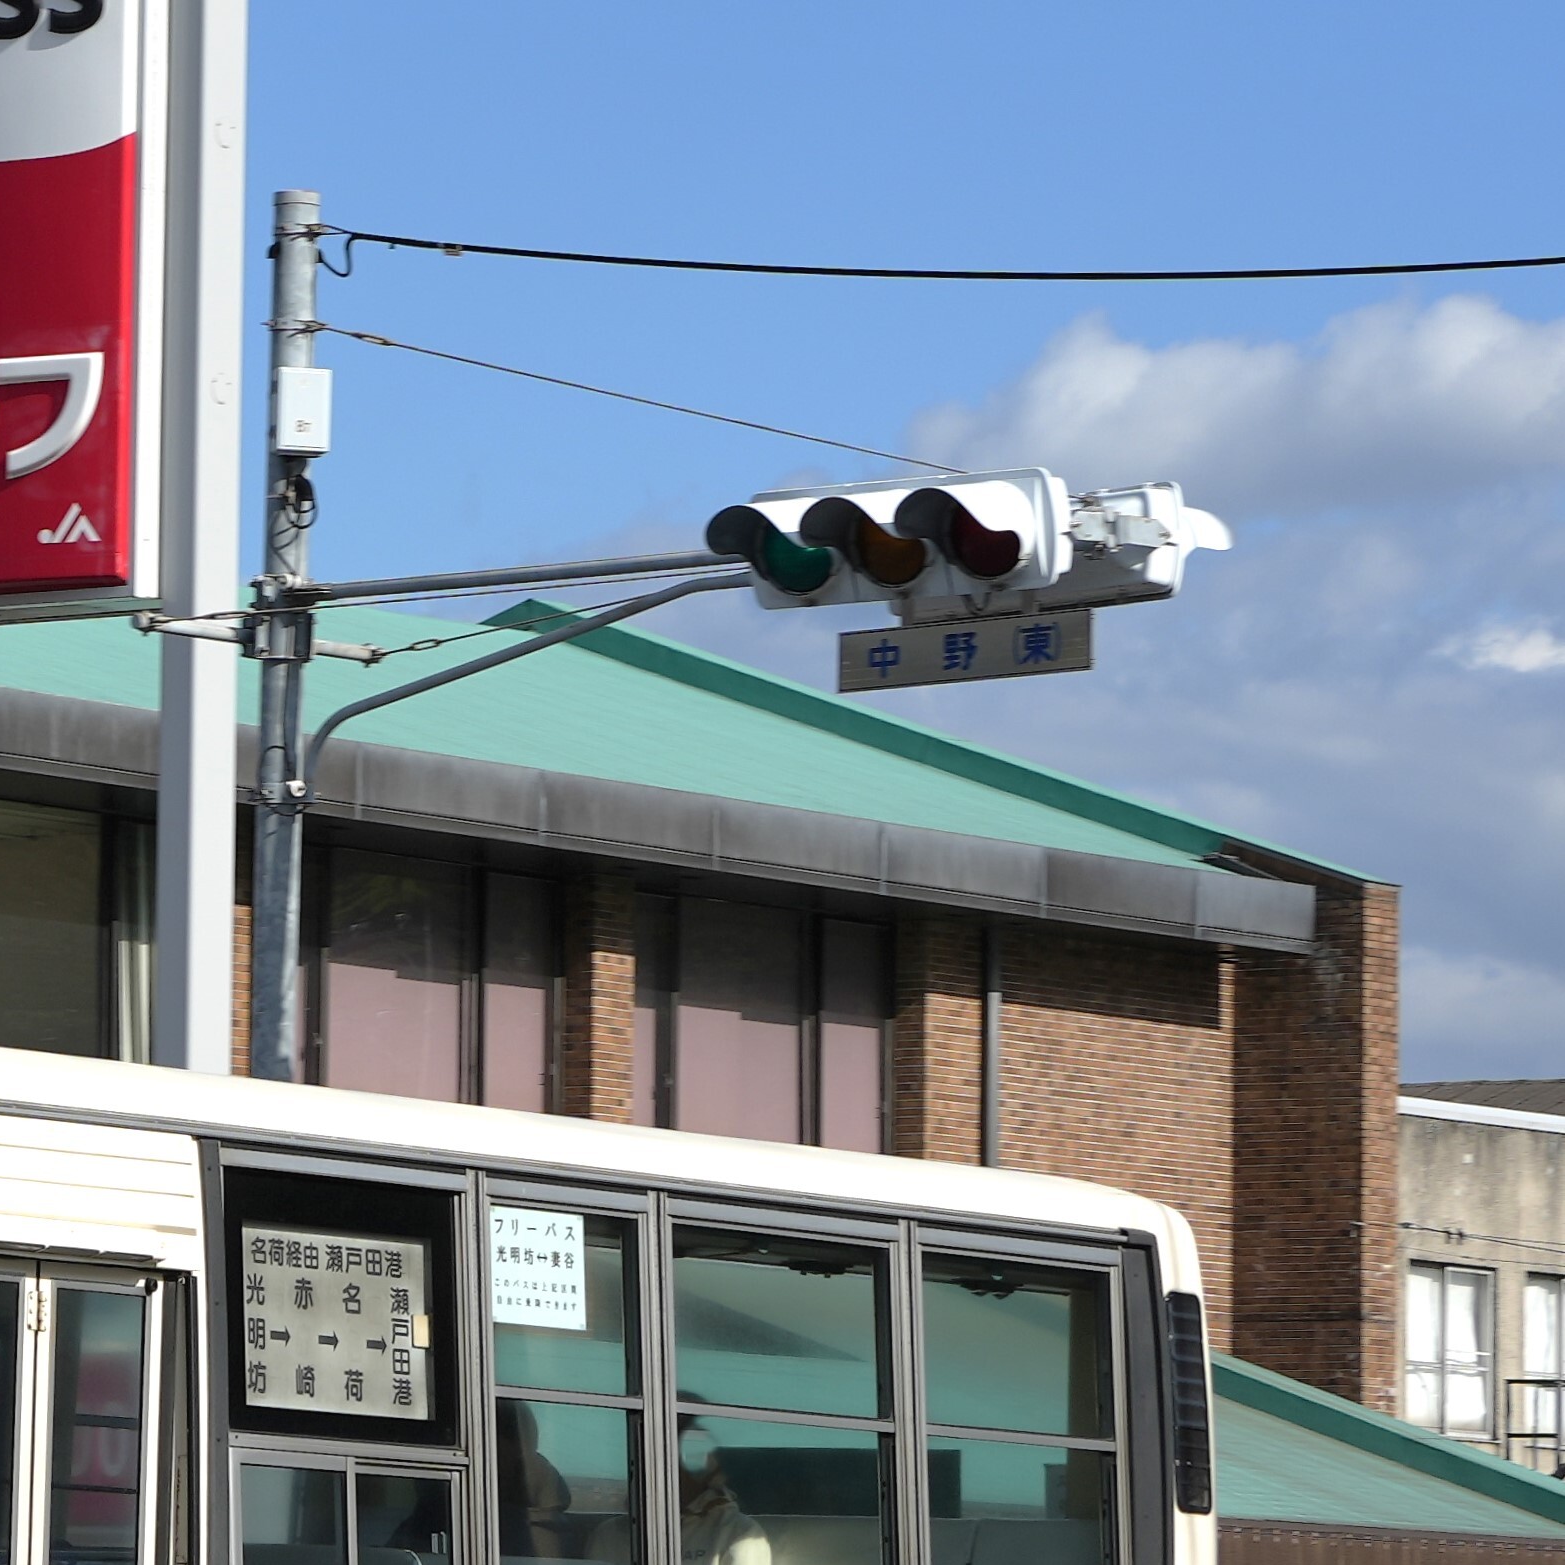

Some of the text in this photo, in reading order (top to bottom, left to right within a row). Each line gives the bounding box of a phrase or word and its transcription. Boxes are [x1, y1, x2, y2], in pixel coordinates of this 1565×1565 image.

[251, 1236, 403, 1279] 名荷経由 瀬戸田港
[496, 1245, 534, 1265] 光明坊
[246, 1273, 267, 1394] 光明坊
[294, 1277, 315, 1398] 赤崎
[342, 1282, 363, 1402] 名荷
[390, 1287, 412, 1406] 瀬戸田港
